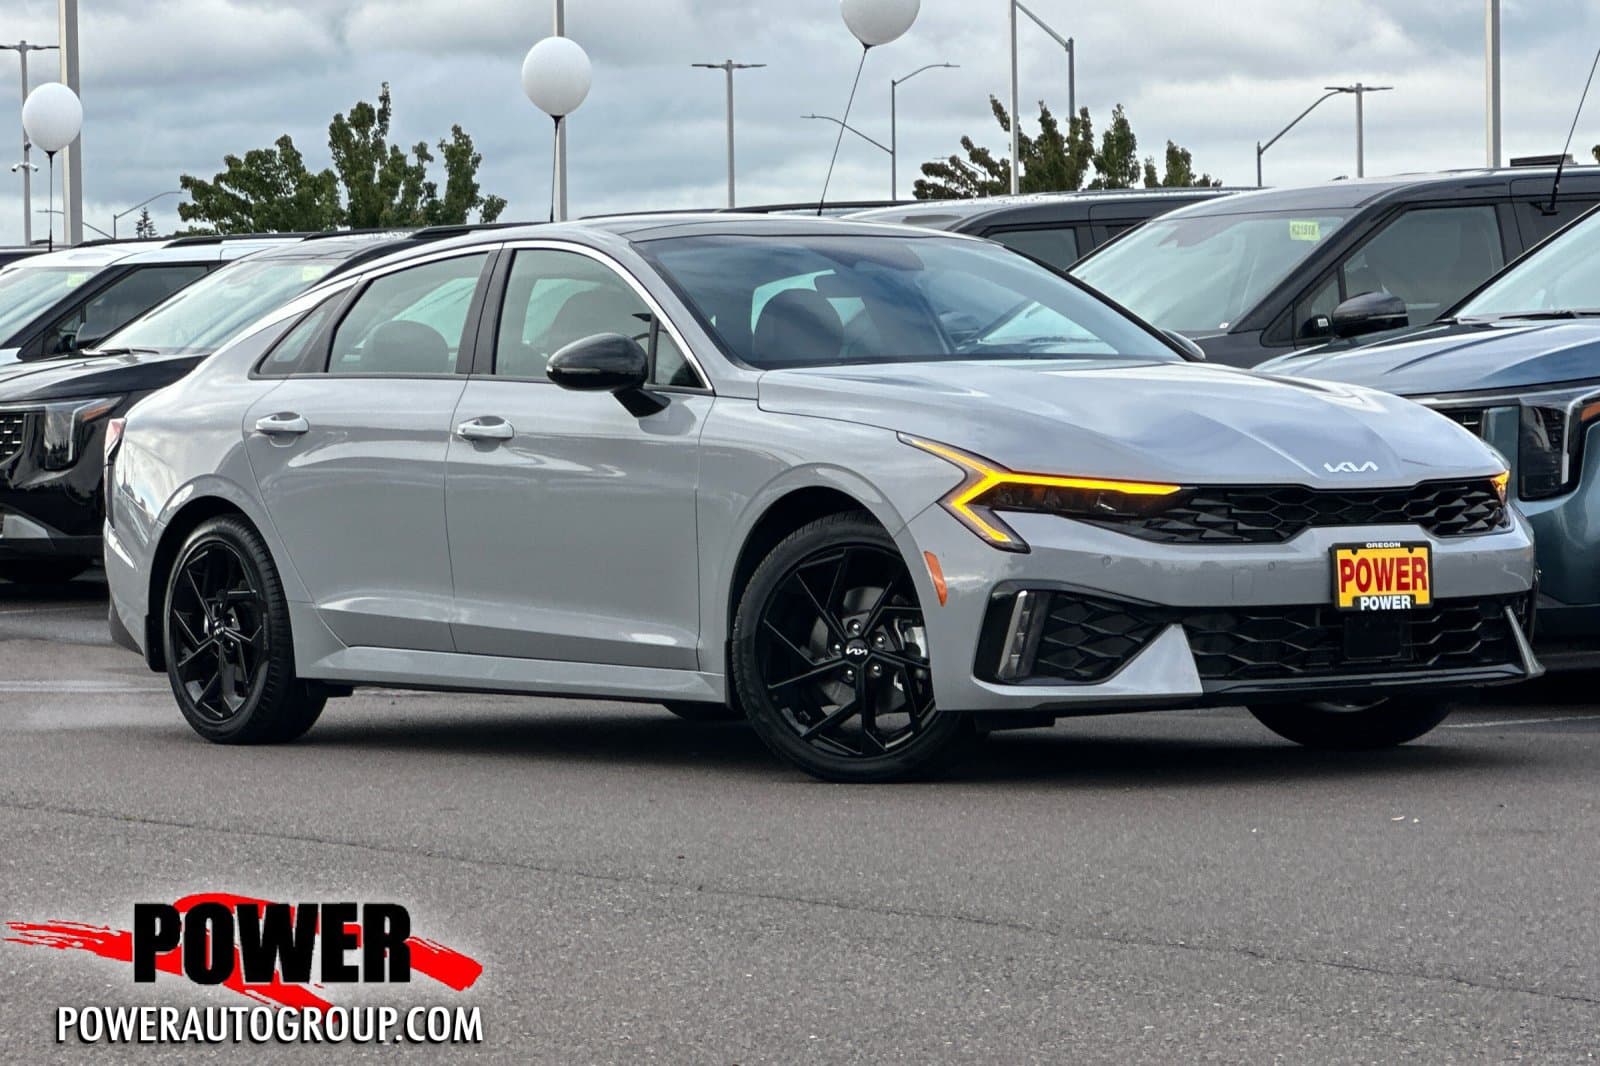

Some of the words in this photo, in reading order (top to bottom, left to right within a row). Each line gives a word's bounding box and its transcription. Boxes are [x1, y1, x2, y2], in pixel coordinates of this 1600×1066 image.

[1366, 541, 1401, 549] OREGON
[1339, 556, 1428, 594] POWER
[1360, 594, 1412, 611] POWER
